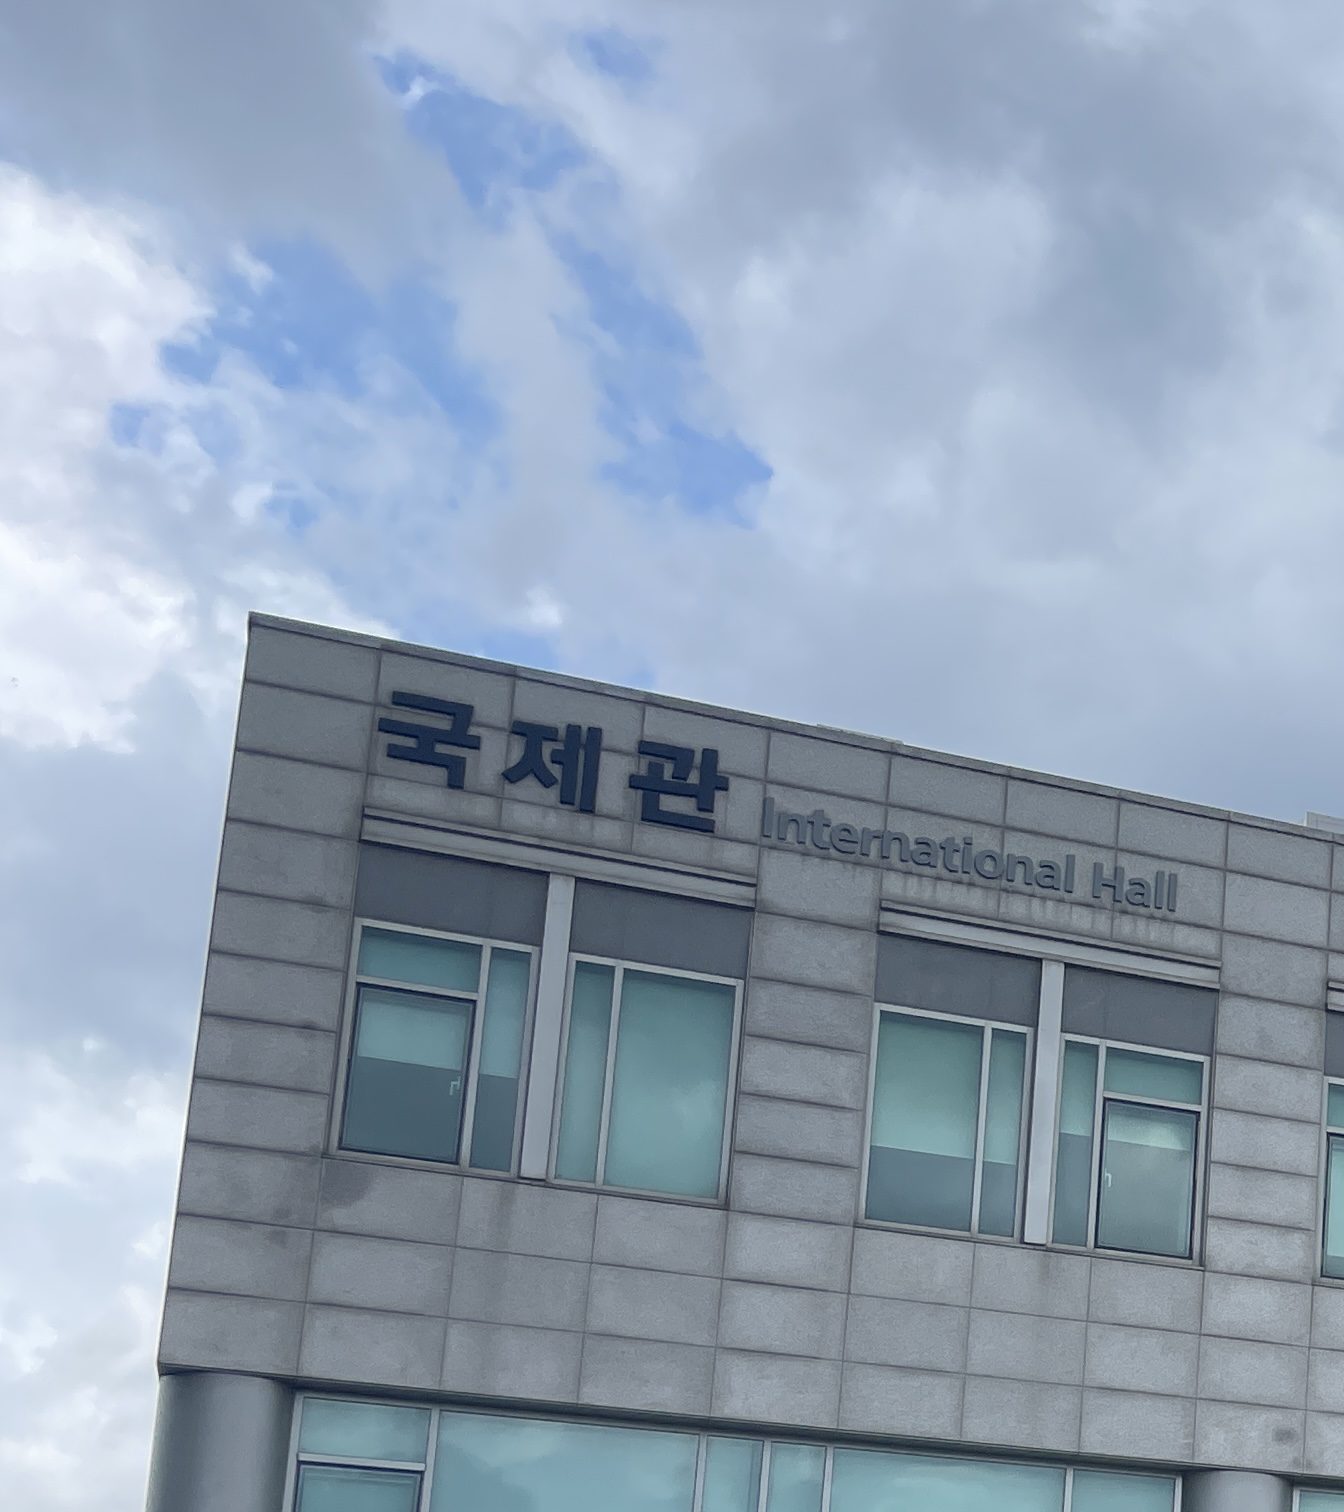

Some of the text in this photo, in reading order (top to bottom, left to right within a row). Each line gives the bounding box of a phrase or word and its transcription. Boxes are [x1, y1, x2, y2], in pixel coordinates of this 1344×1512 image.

[378, 690, 730, 834] 국제관
[761, 796, 1178, 913] International Hall
